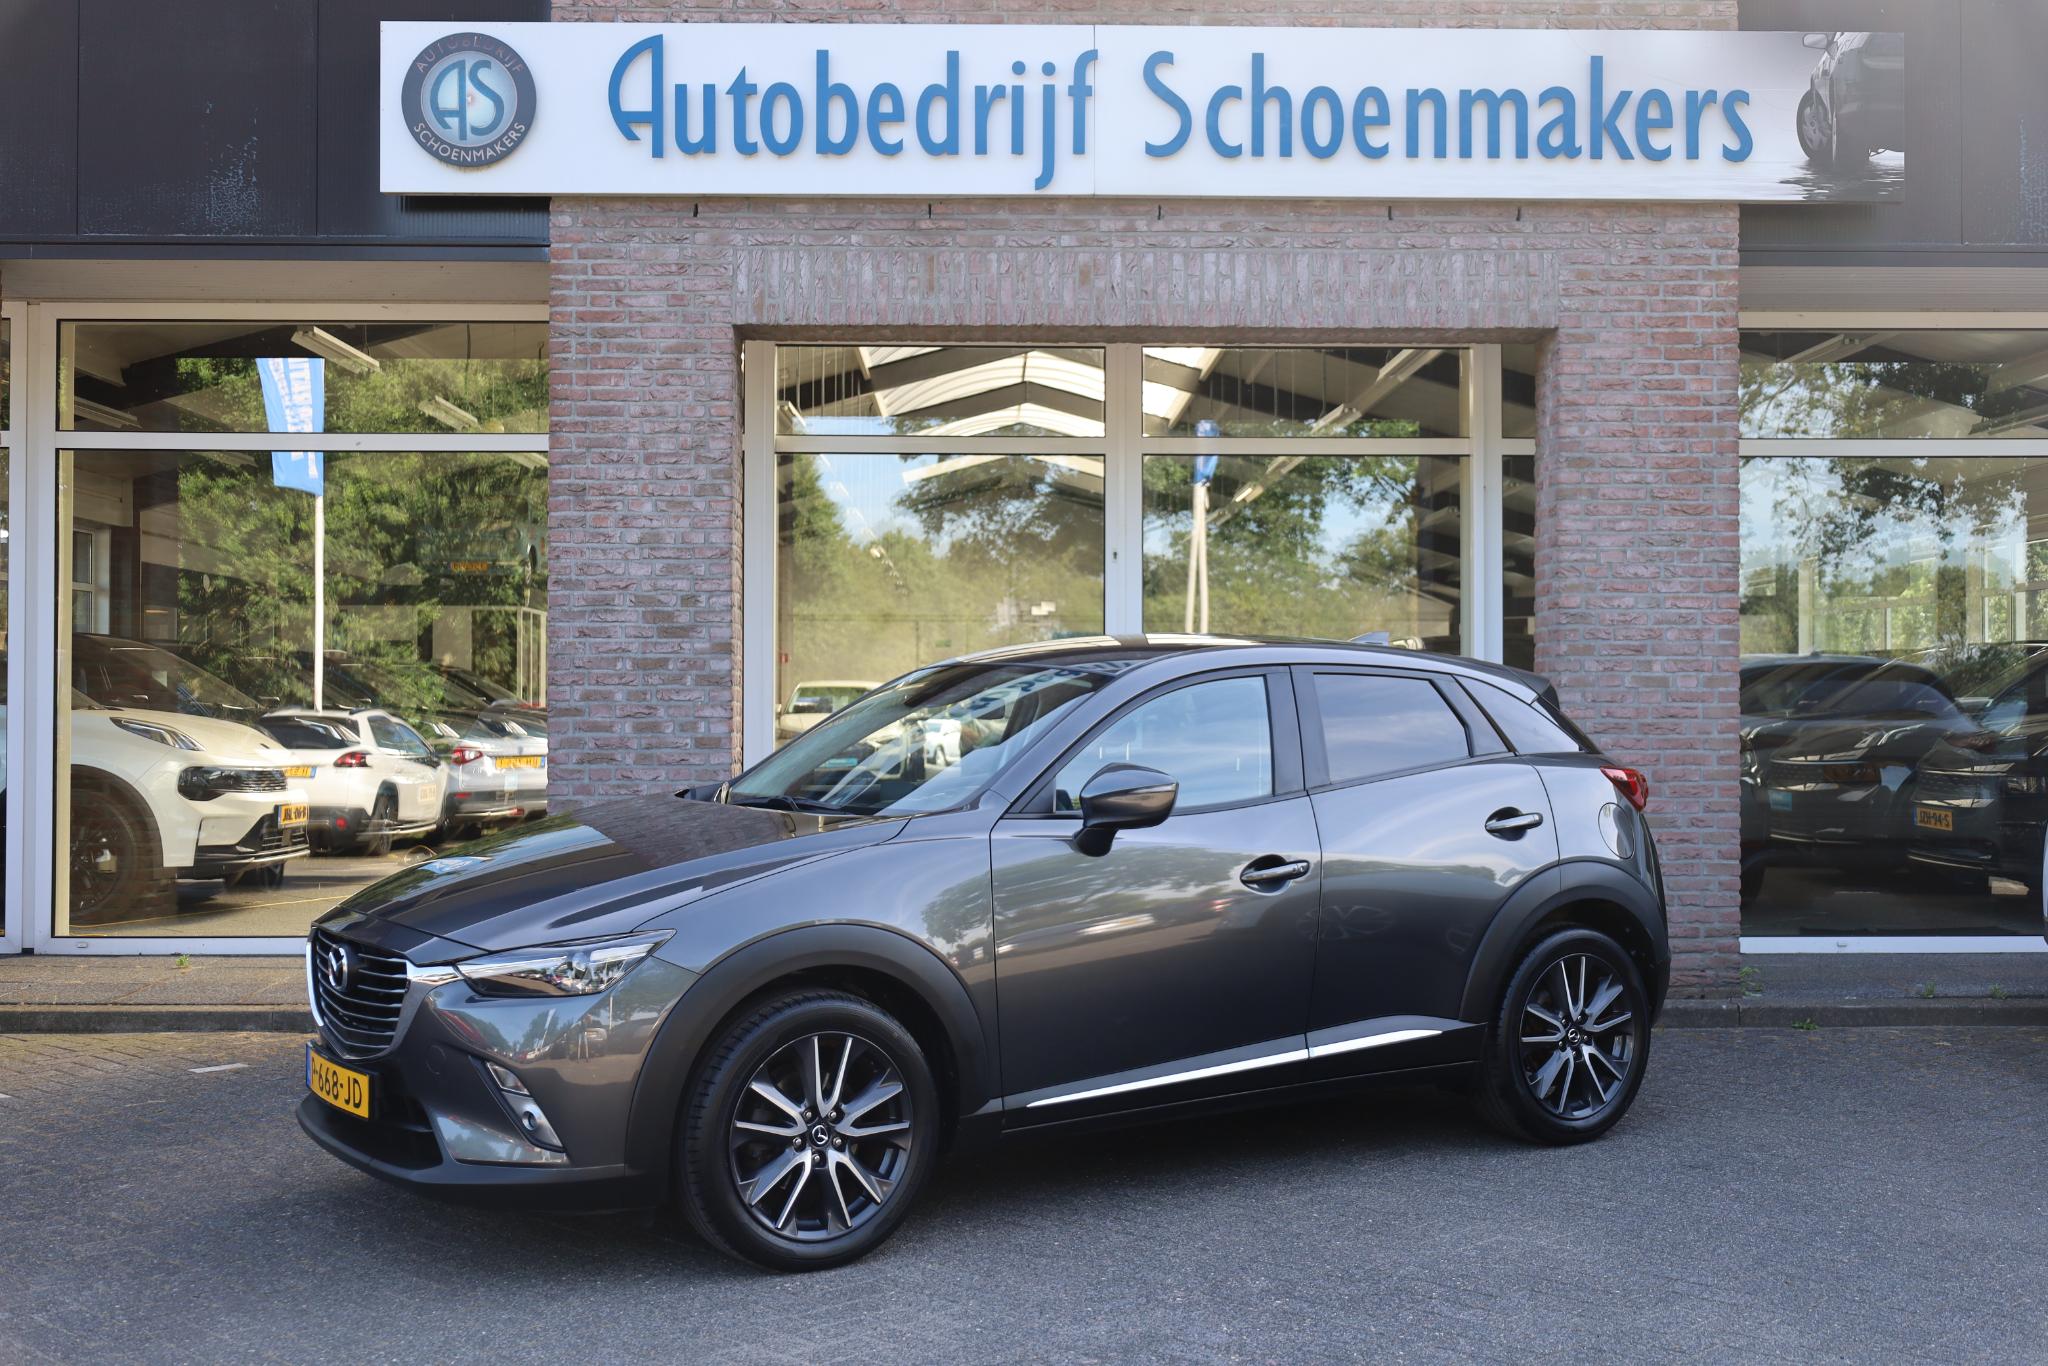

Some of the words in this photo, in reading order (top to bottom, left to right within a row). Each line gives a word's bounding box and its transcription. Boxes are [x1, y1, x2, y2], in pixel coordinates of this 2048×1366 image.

[430, 59, 505, 141] AS
[608, 33, 1098, 191] Autobedrijf
[1142, 50, 1754, 163] Schoenmakers
[413, 122, 526, 162] SCHOENMAKERS
